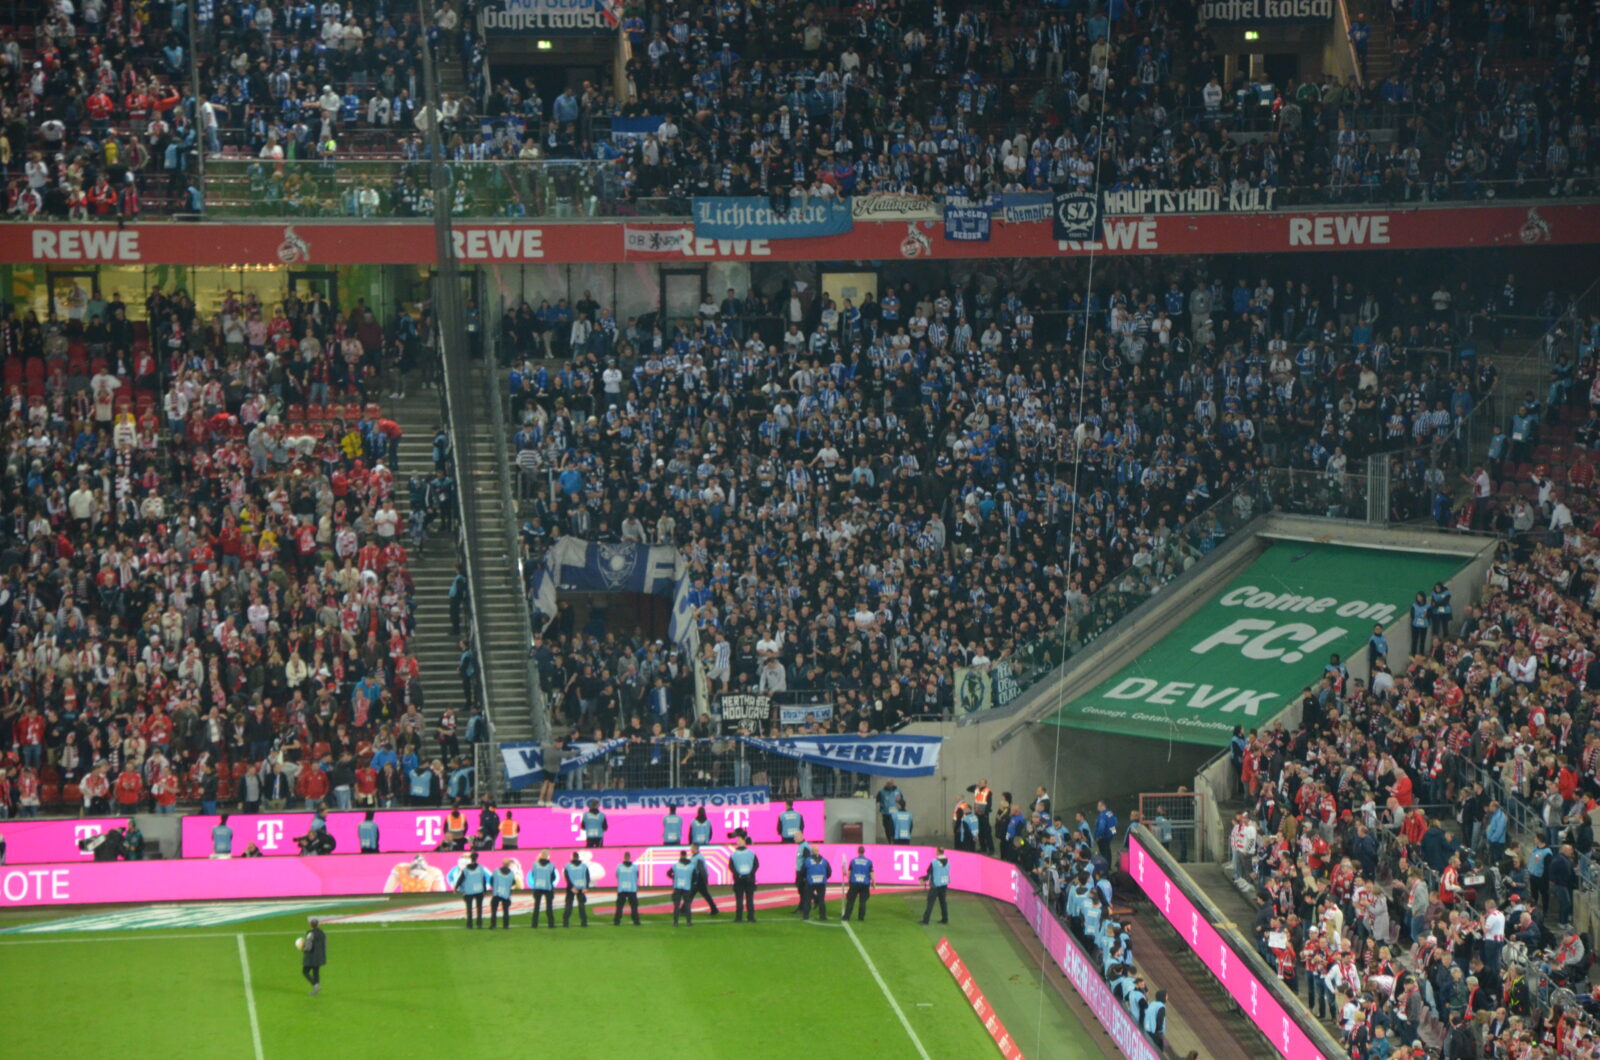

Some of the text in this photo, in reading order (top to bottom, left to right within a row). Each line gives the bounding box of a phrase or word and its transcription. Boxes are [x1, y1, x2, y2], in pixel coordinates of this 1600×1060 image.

[1067, 202, 1089, 220] SZ
[32, 229, 141, 260] REWE
[447, 229, 544, 259] REWE
[1289, 216, 1391, 246] REWE
[1219, 585, 1397, 625] Come on,
[1190, 618, 1349, 664] FC!
[1102, 677, 1280, 716] DEVK
[816, 743, 925, 766] VEREIN
[639, 790, 766, 808] INVESTOREN
[0, 870, 70, 901] OTE
